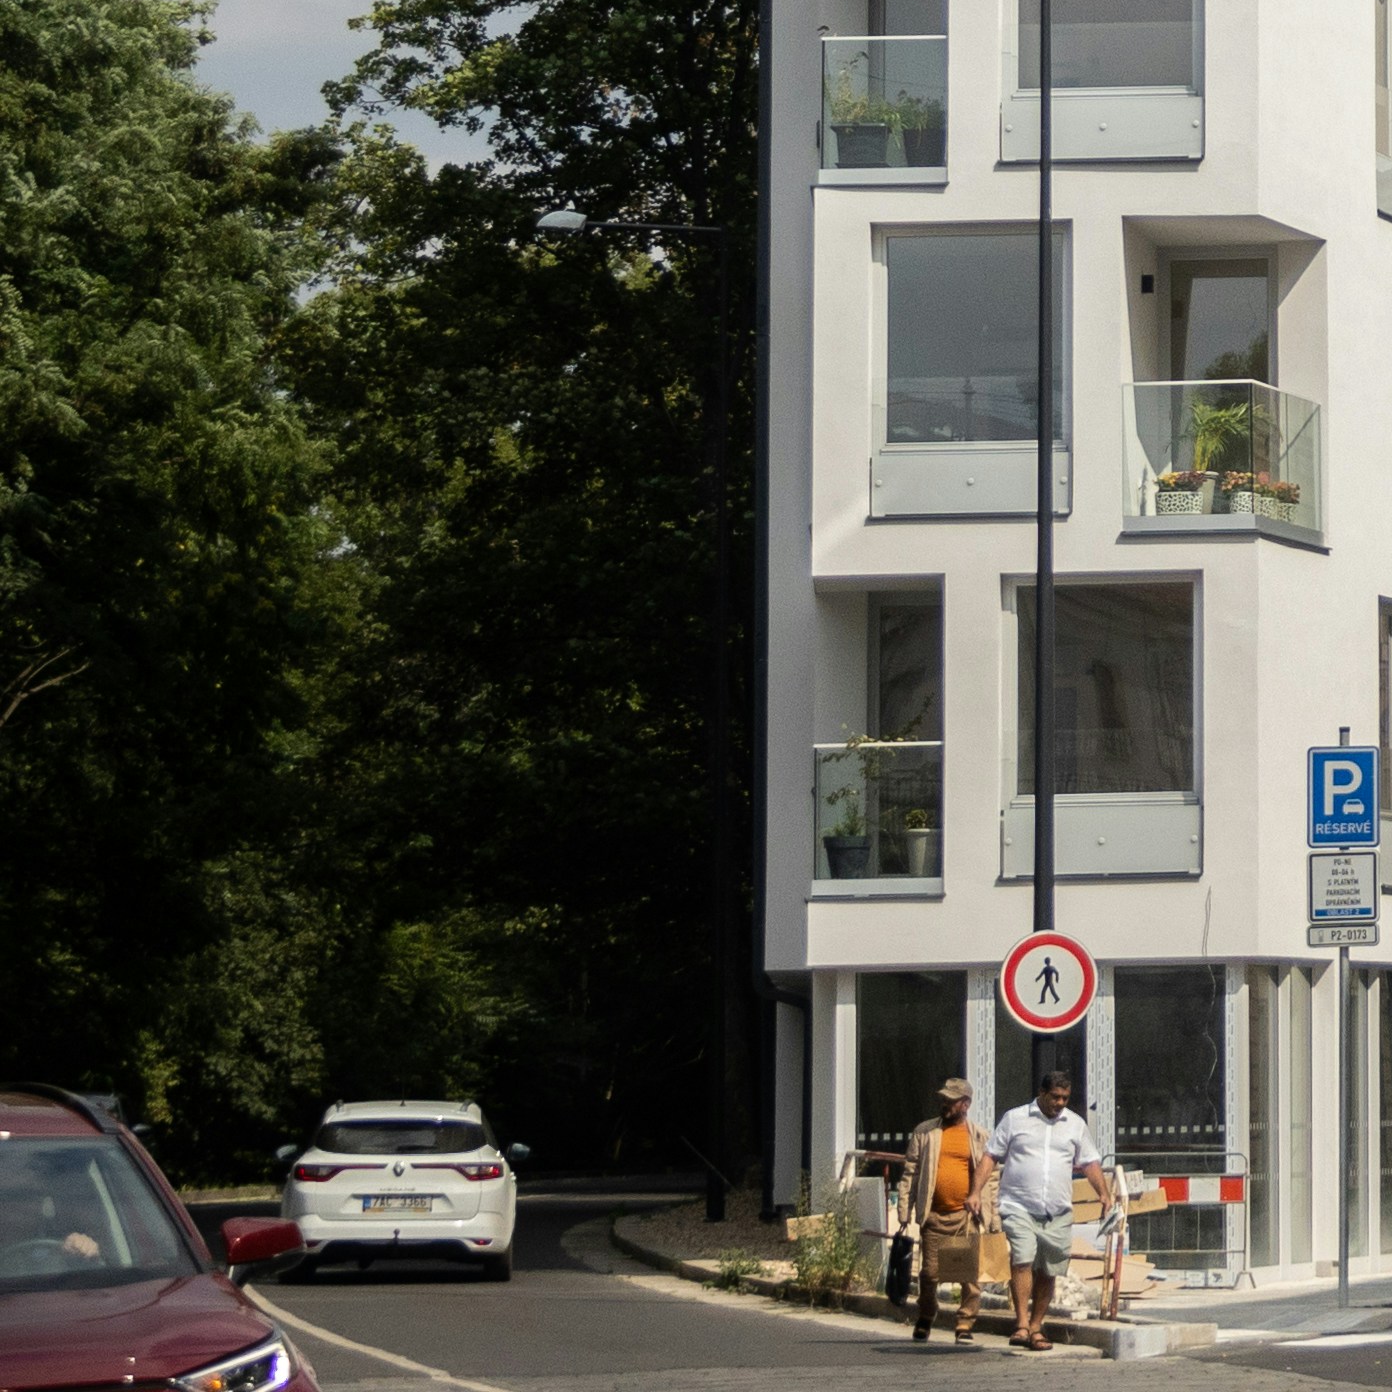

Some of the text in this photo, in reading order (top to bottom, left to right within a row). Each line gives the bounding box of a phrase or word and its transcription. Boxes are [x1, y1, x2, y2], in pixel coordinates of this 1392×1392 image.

[1323, 760, 1363, 816] P
[1315, 819, 1371, 834] RÉSERVÉ
[1331, 929, 1367, 941] P2-0173
